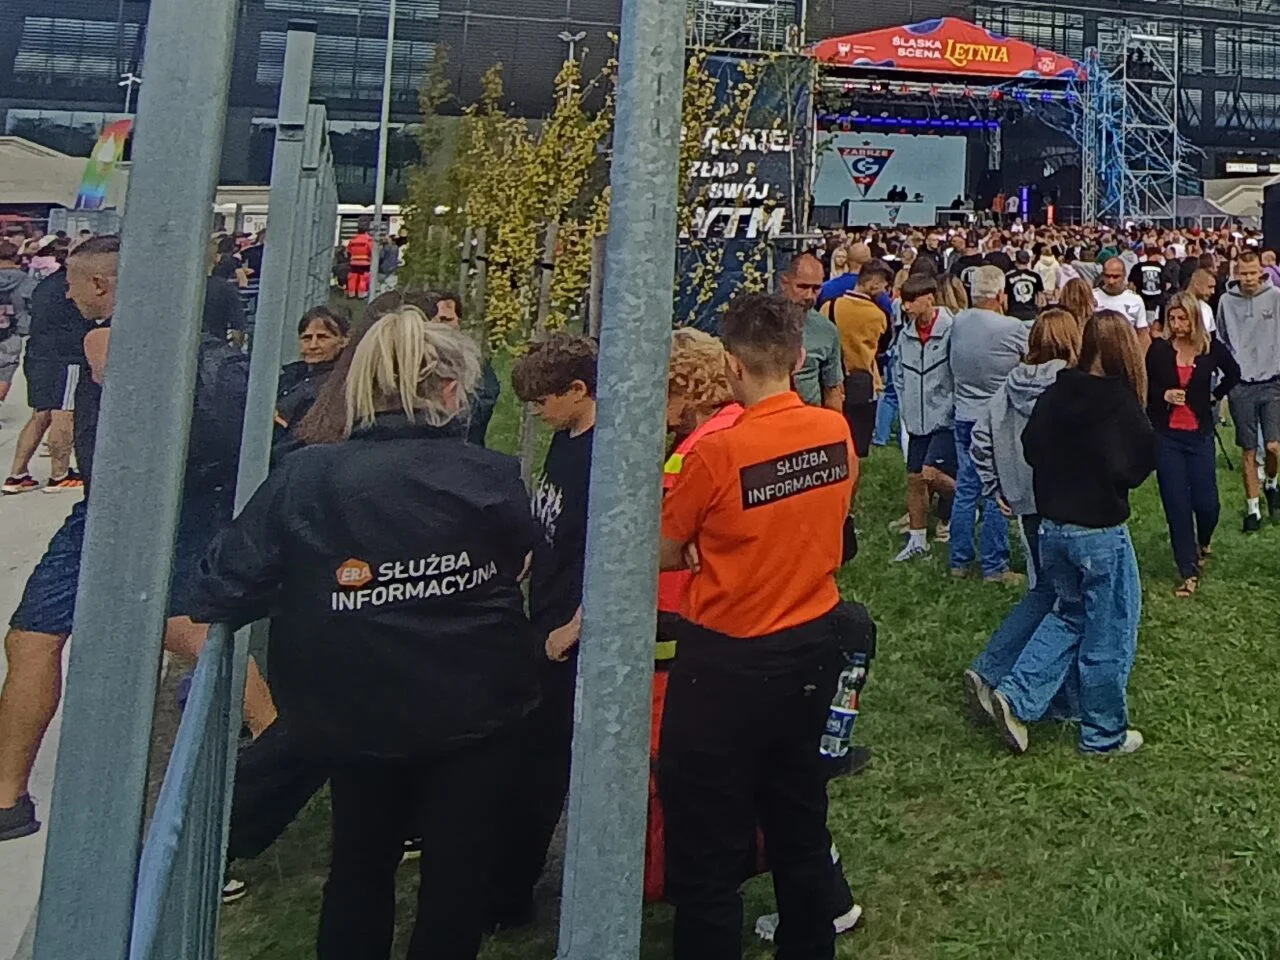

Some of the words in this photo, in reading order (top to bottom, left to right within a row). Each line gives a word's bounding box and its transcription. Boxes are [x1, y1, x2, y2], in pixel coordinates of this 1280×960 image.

[892, 35, 942, 49] ŚLĄSKA
[897, 47, 942, 59] SCENA
[944, 39, 1009, 67] LETNIA
[842, 148, 889, 157] ZABRZE
[679, 207, 786, 239] YTM
[776, 450, 828, 476] SŁUŻBA
[342, 567, 372, 582] ERA
[377, 551, 471, 582] SŁUŻBA
[331, 560, 498, 611] INFORMACYJNA
